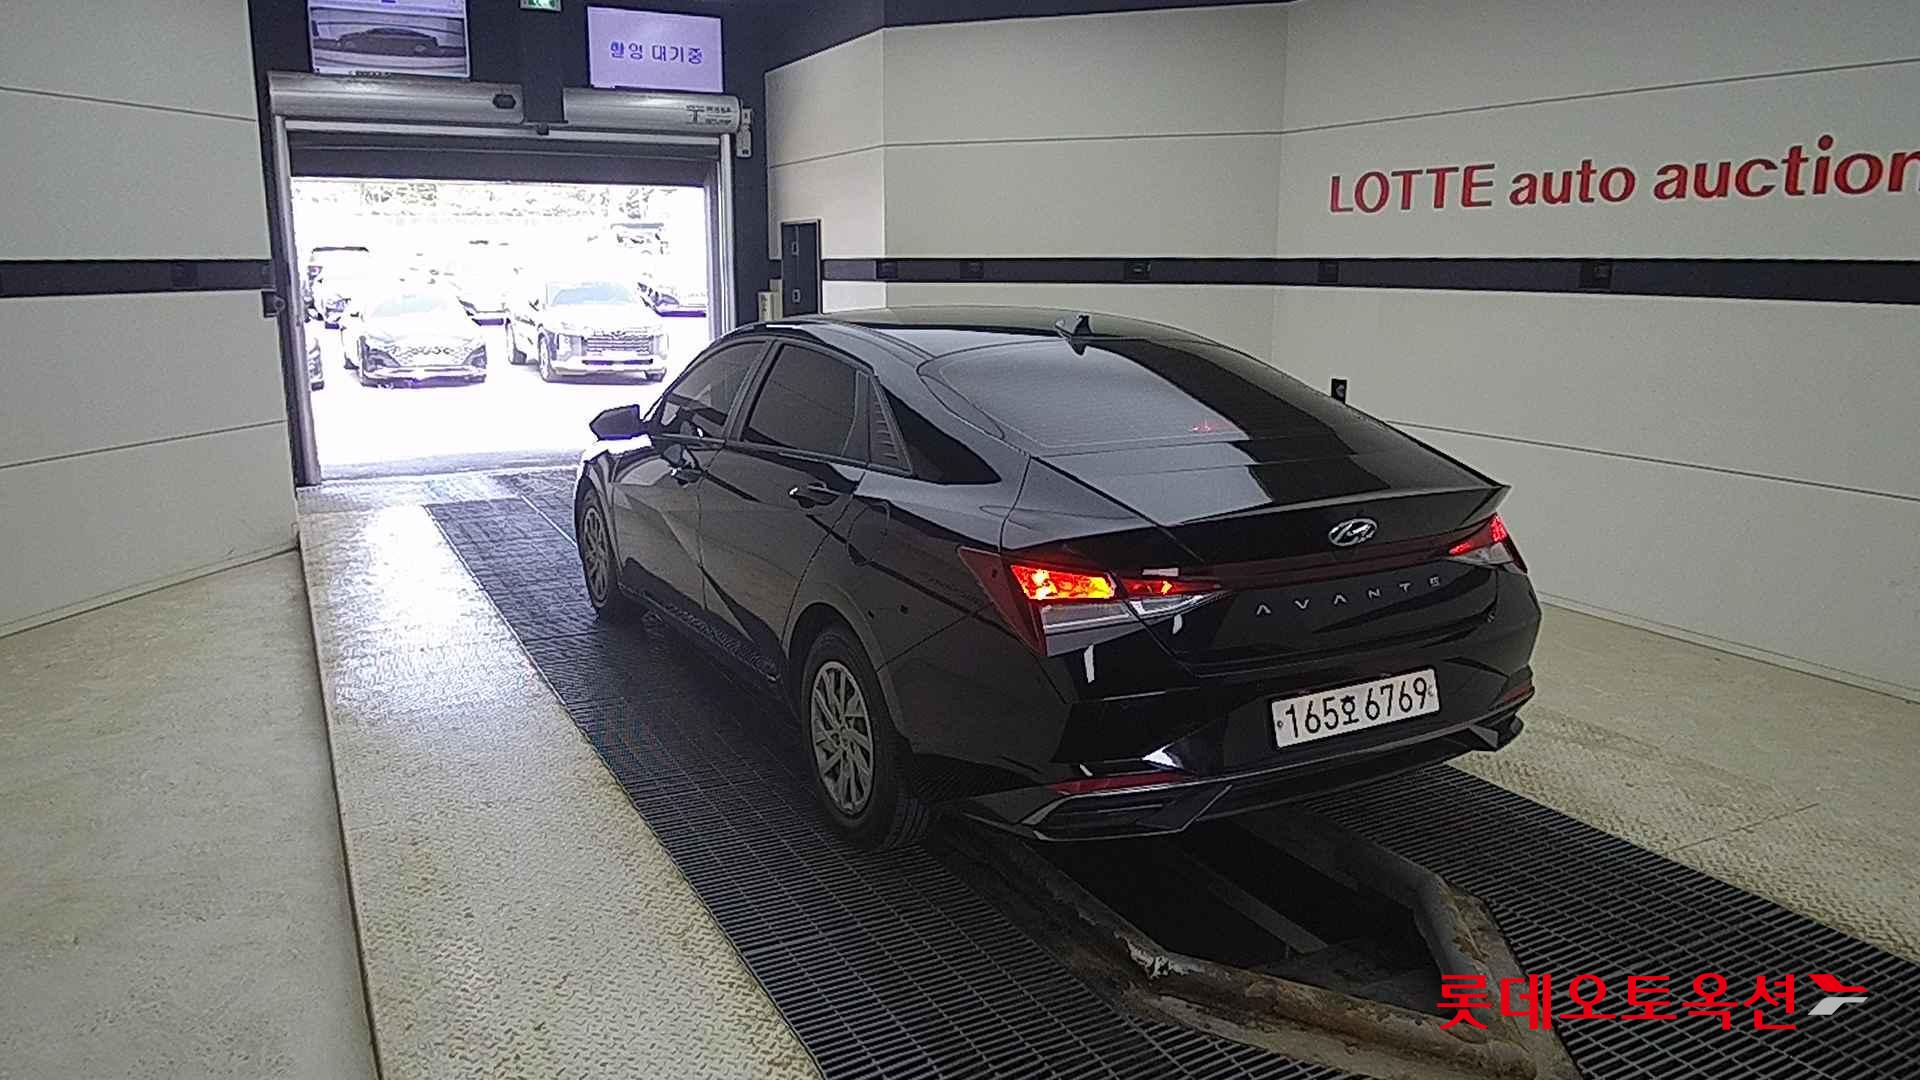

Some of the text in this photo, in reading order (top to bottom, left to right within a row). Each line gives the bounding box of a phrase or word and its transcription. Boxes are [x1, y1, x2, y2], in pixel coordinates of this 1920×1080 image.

[652, 45, 702, 65] 대기중
[1330, 134, 1920, 213] LOTTE auto auction
[1256, 576, 1441, 616] AVANTE
[1285, 677, 1427, 738] 165호6769
